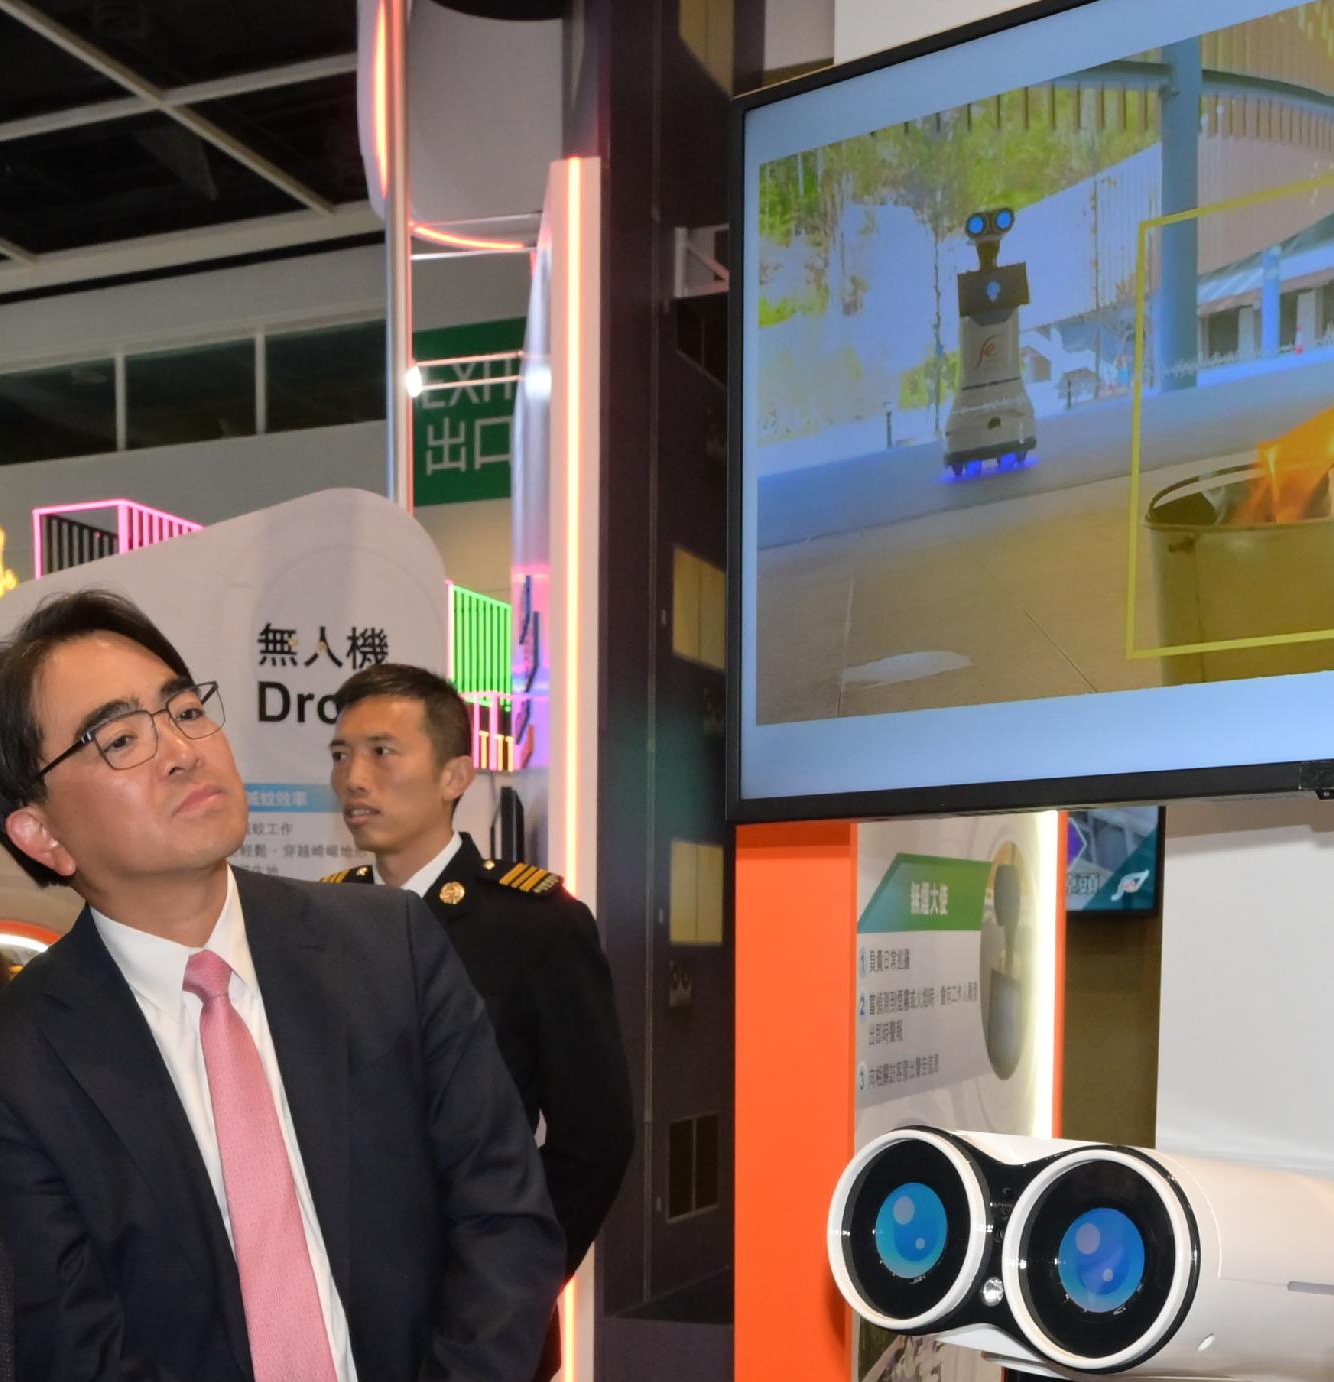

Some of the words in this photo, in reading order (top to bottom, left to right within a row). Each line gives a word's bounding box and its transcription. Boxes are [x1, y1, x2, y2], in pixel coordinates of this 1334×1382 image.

[426, 416, 514, 476] 出口
[257, 623, 389, 670] 無人機
[247, 822, 293, 836] 蚊工作
